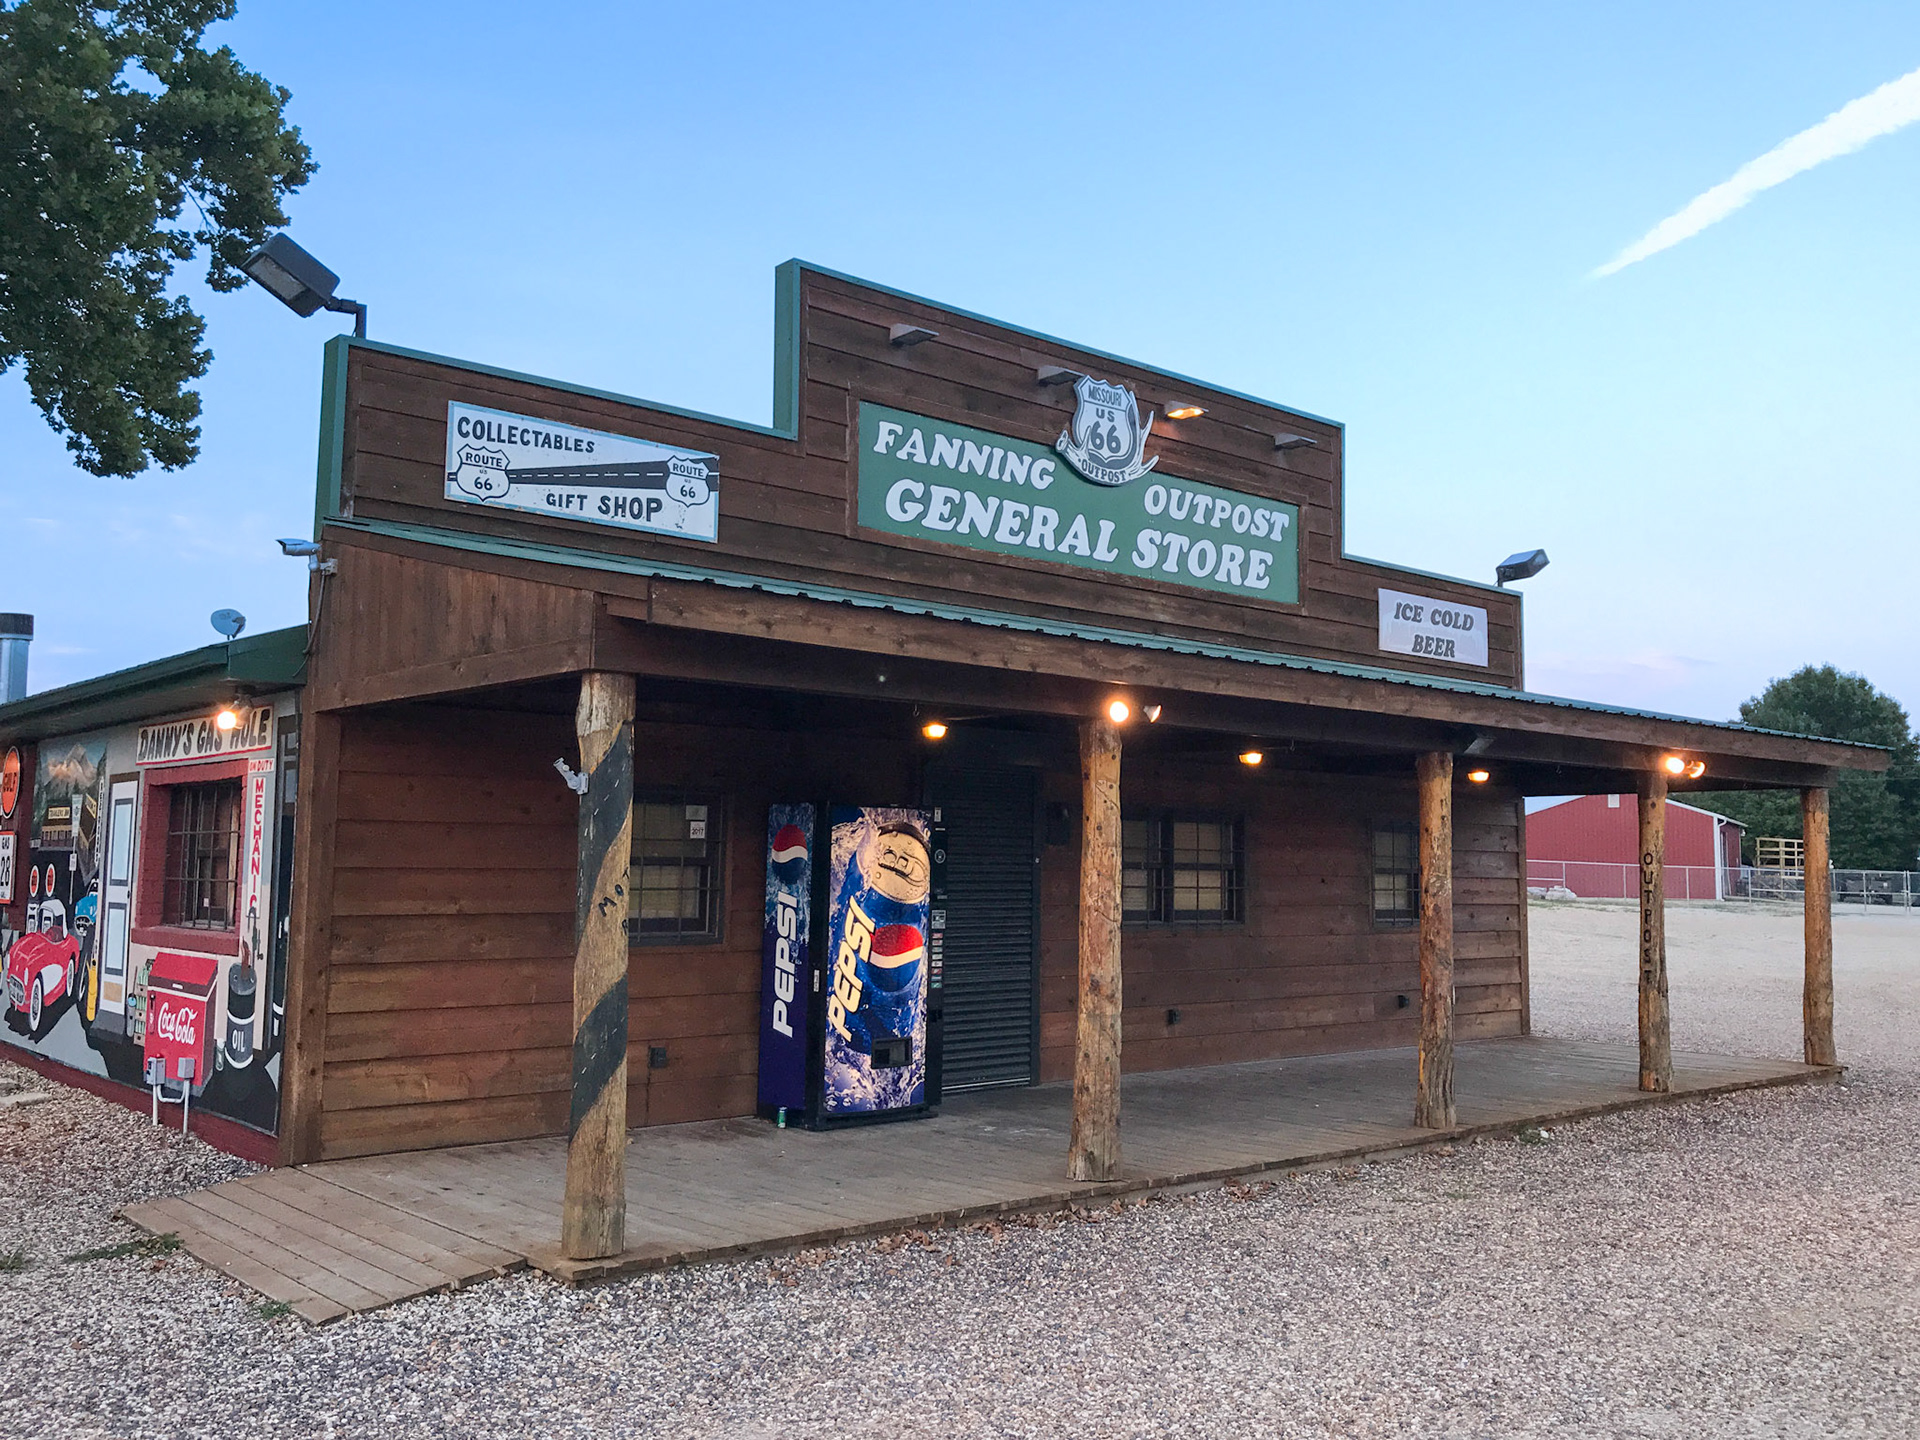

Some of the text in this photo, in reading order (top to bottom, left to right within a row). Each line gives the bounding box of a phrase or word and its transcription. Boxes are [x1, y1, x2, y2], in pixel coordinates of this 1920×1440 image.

[1088, 385, 1122, 407] MISSOURI
[1096, 408, 1115, 423] US
[457, 416, 595, 454] COLLECTABLES
[1091, 421, 1121, 454] 66
[465, 452, 503, 467] ROUTE
[672, 463, 704, 477] ROUTE
[1081, 459, 1126, 483] OUTPOST
[474, 477, 493, 491] 66
[680, 485, 696, 498] 66
[873, 421, 1290, 542] FANNING OUTPOST
[546, 493, 663, 522] GIFT SHOP
[885, 479, 1273, 590] GENERAL STORE
[1394, 602, 1475, 631] ICE COLD
[1411, 634, 1456, 658] BEER
[138, 722, 195, 761] DANNY'S
[257, 759, 273, 771] DUTY
[1643, 852, 1653, 984] OUTPOST
[773, 891, 797, 1039] PEPSI
[828, 895, 876, 1042] PEPSI
[232, 1030, 245, 1052] OIL
